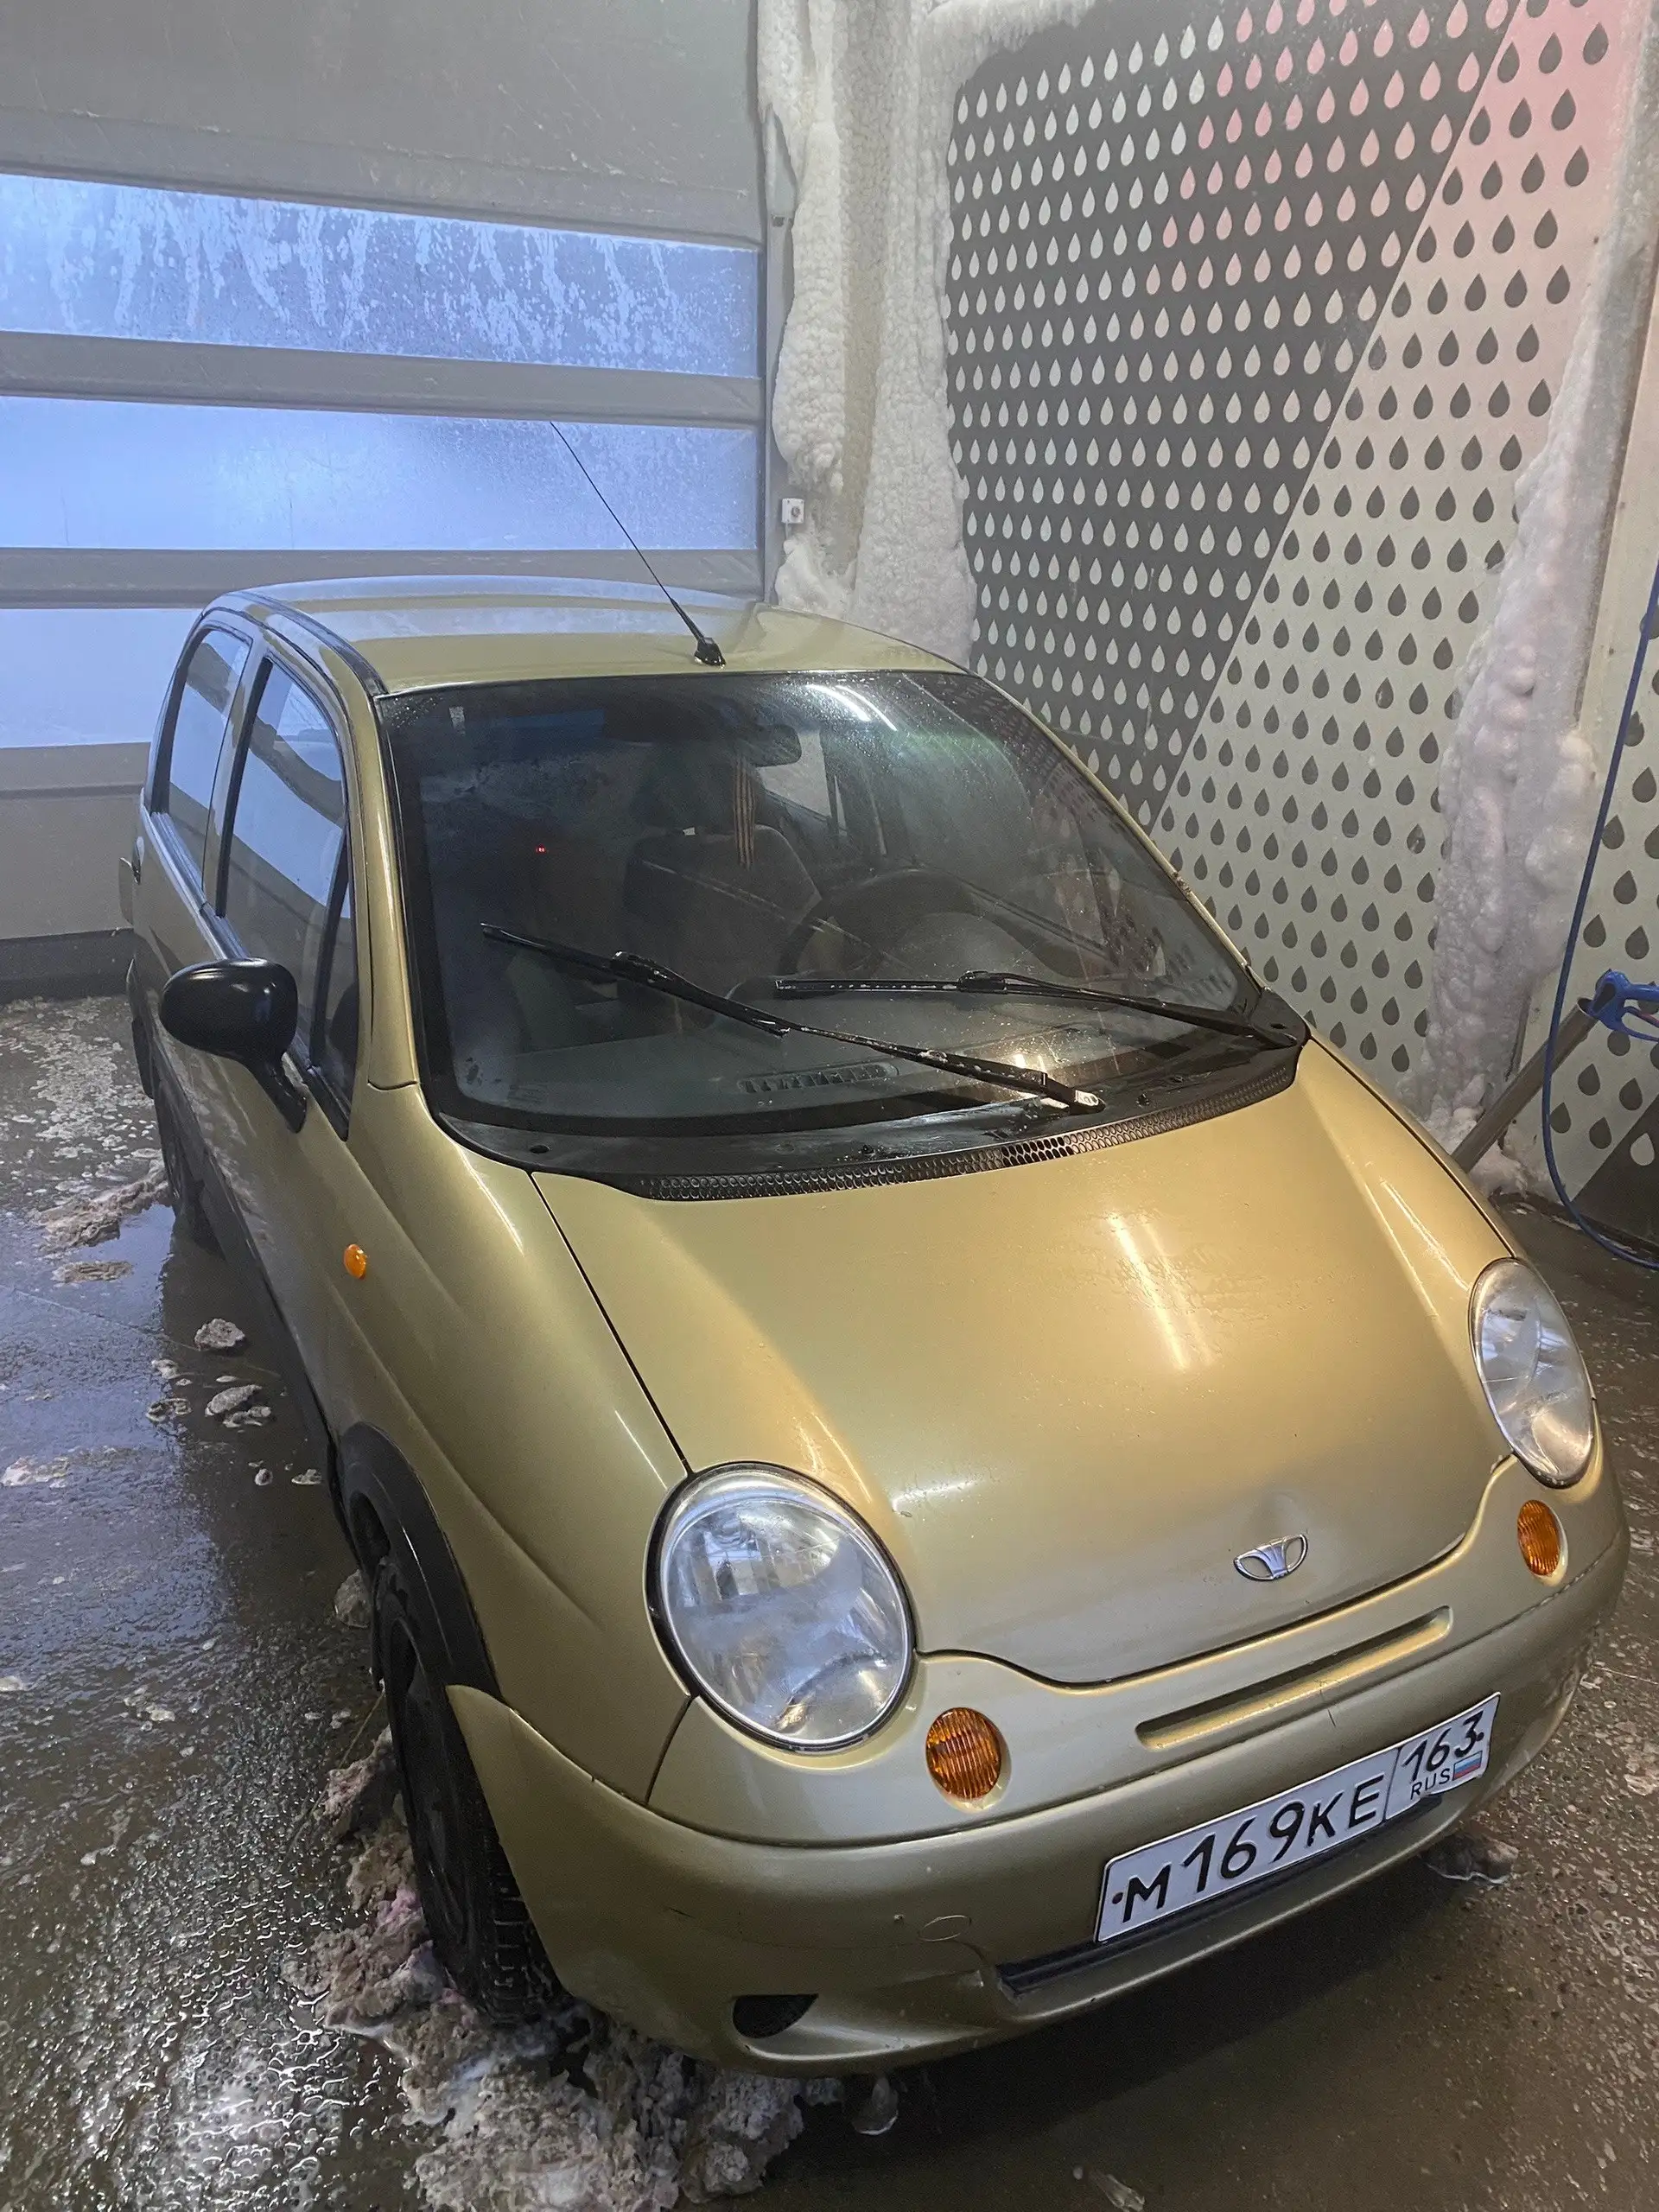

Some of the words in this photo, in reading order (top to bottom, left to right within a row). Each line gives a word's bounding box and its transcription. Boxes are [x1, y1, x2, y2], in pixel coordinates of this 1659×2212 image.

[1122, 1774, 1384, 1923] М169КЕ
[1402, 1711, 1484, 1783] 163
[1410, 1767, 1451, 1800] RUS
